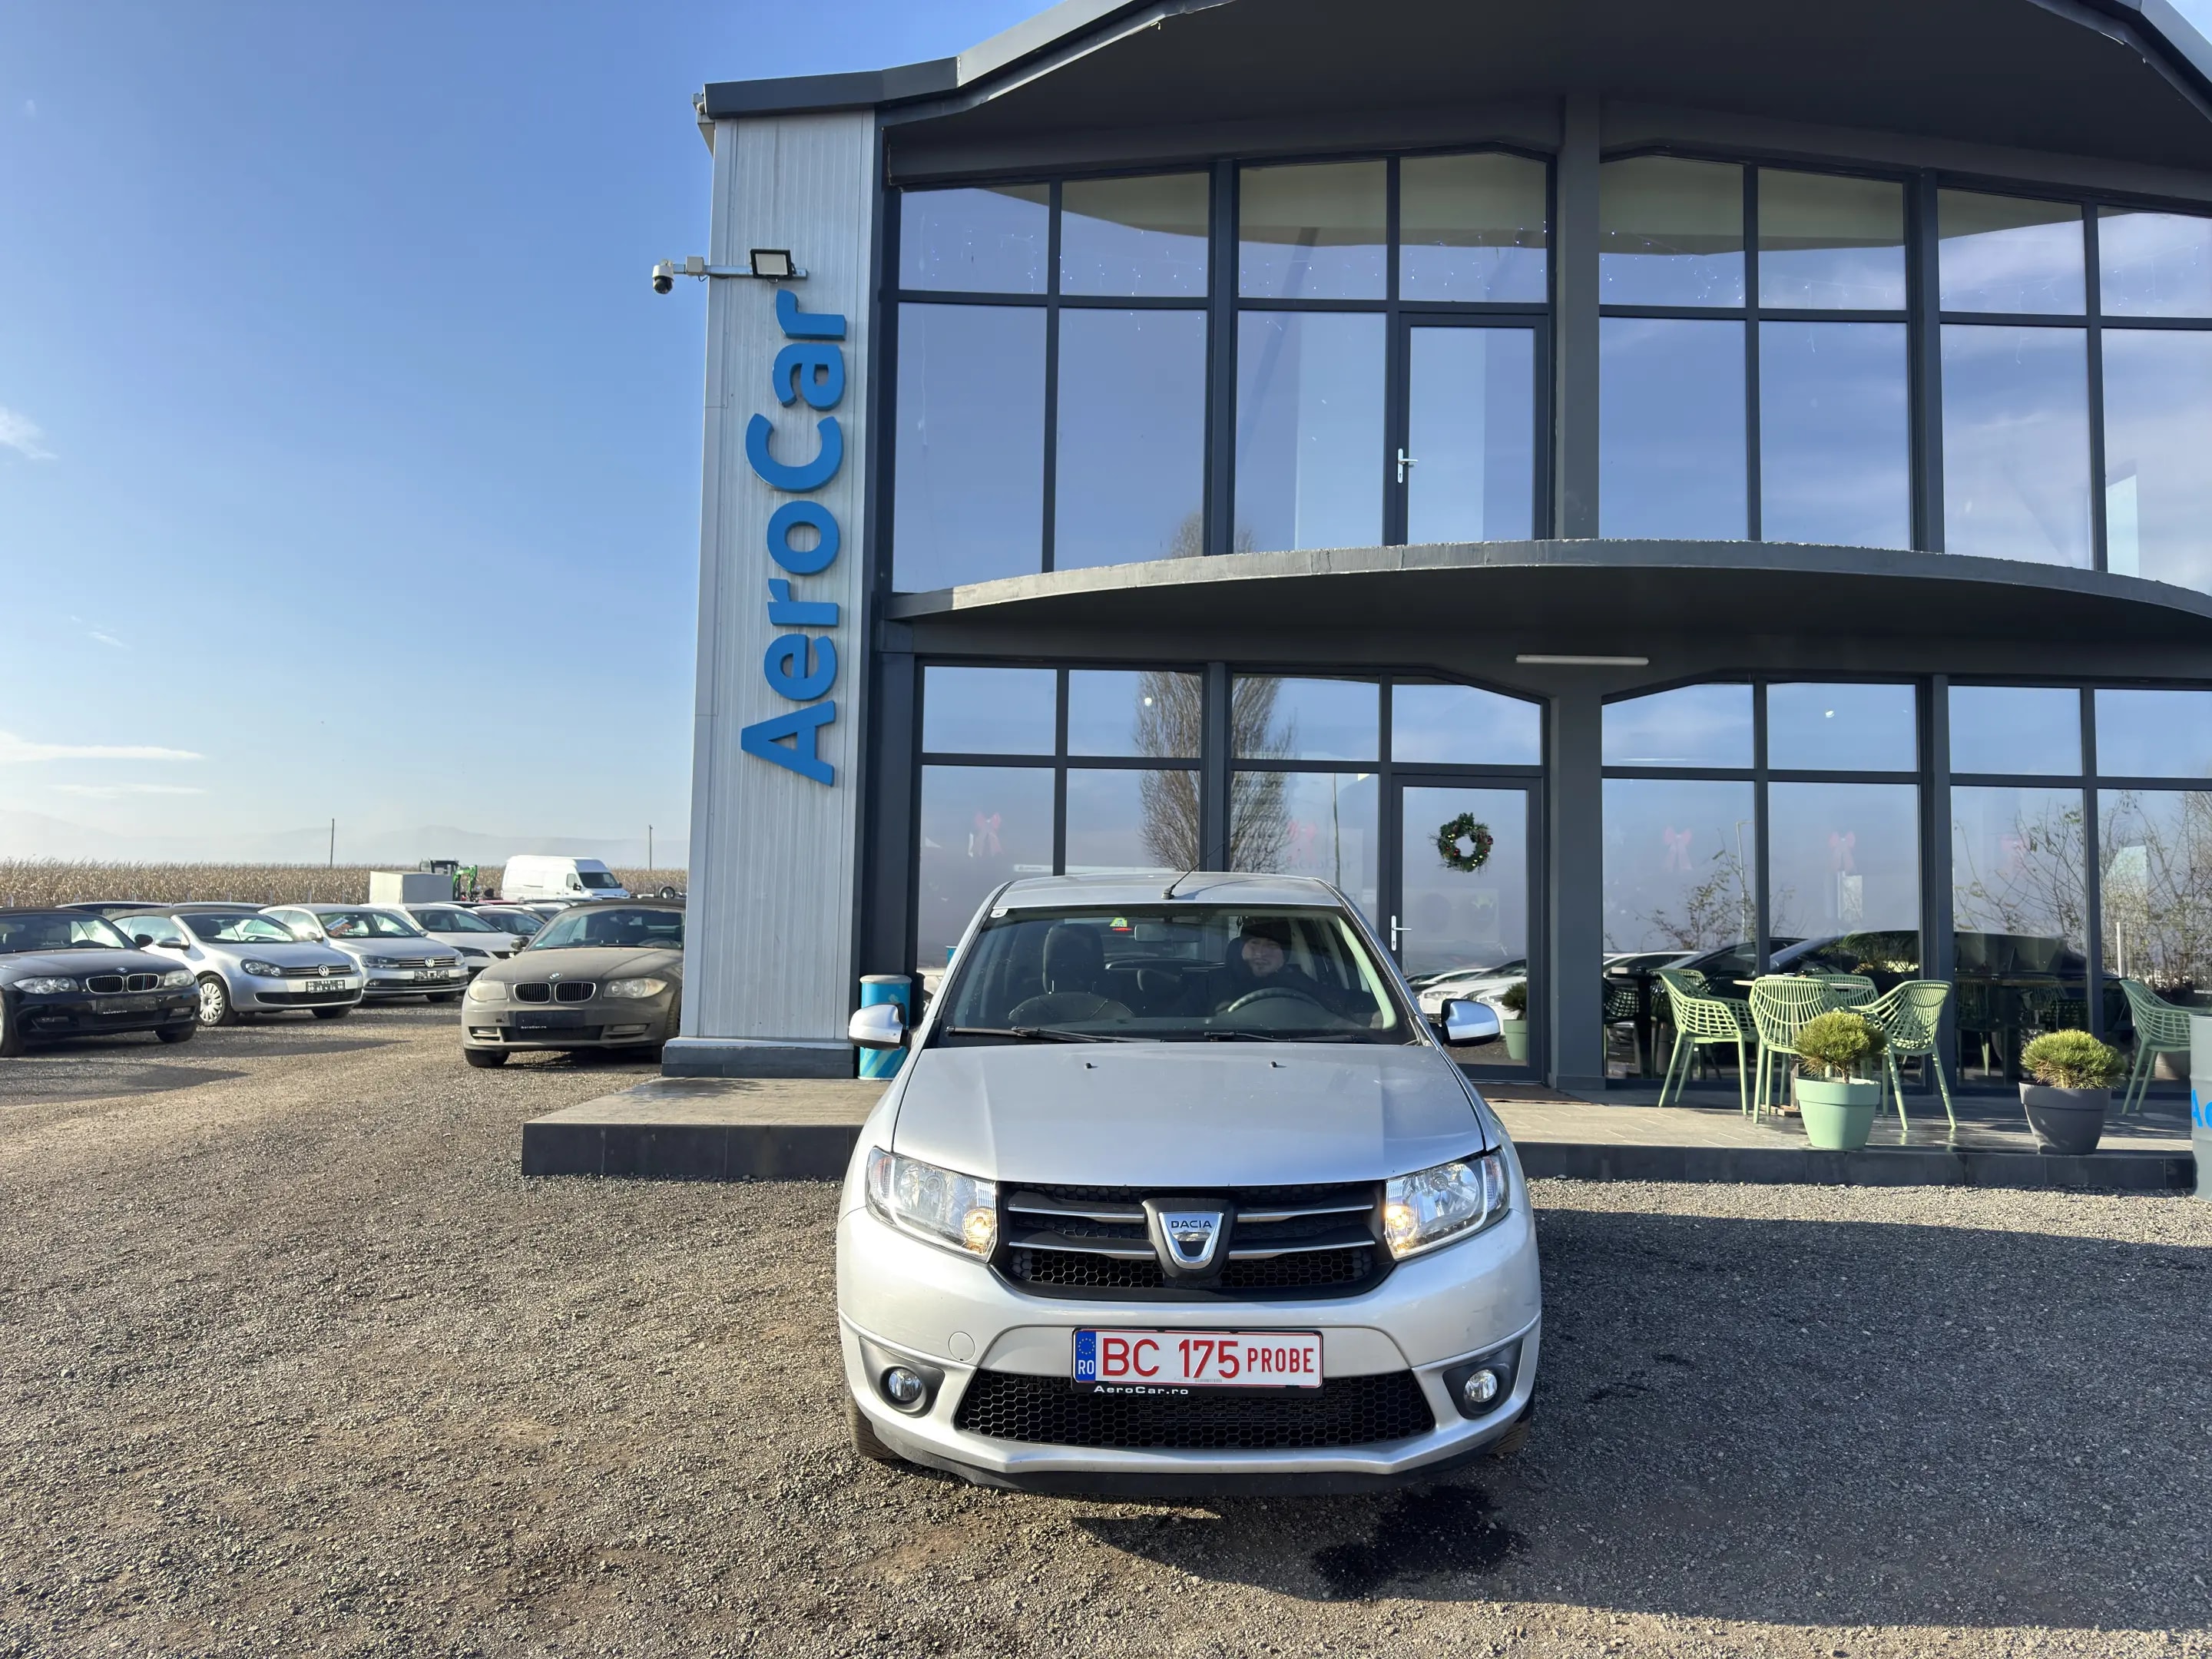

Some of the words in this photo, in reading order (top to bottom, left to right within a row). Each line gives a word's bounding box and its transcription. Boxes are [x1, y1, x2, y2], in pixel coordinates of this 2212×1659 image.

[740, 289, 846, 787] AeroCar
[1171, 1220, 1213, 1228] DACIA
[1078, 1359, 1094, 1375] RO
[1102, 1337, 1160, 1377] BC
[1178, 1339, 1240, 1379] 175
[1247, 1347, 1314, 1373] PROBE
[1094, 1385, 1189, 1395] AeroCar.ro
